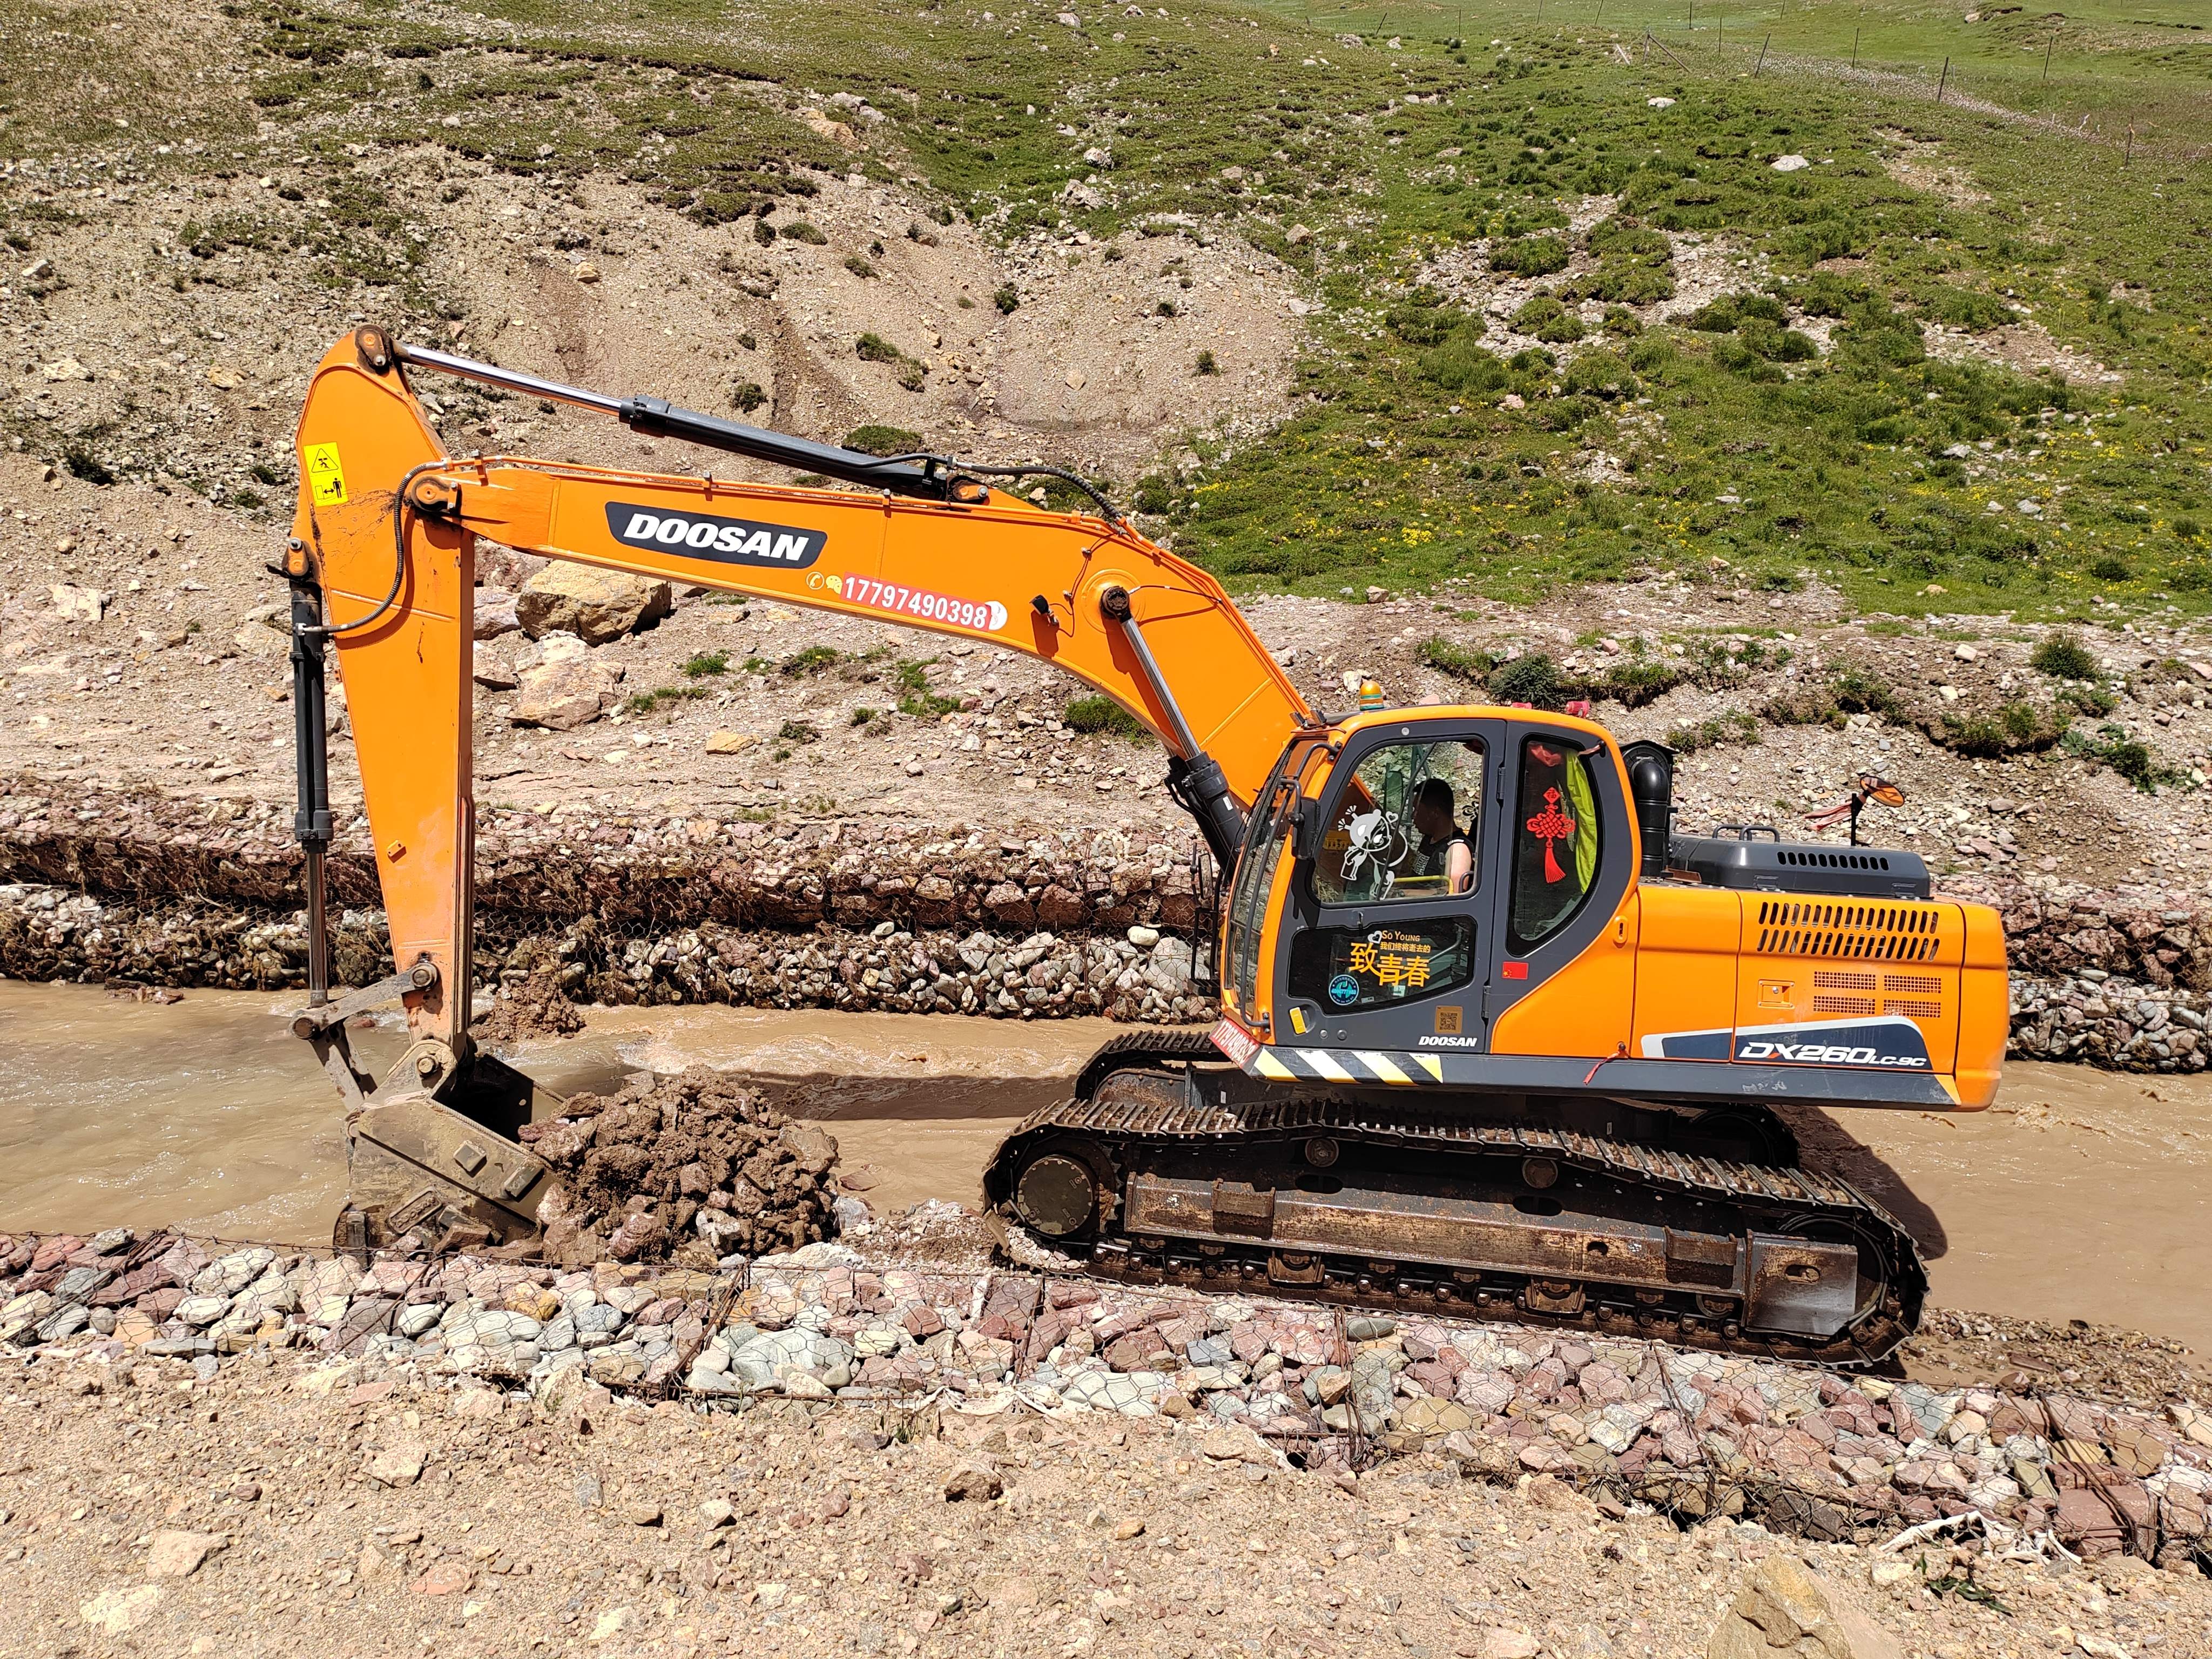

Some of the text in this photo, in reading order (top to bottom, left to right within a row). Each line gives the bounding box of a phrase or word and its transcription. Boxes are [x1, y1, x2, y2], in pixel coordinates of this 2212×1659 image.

[623, 513, 810, 561] DOOSAN
[845, 576, 988, 629] 17797490398
[1348, 942, 1431, 987] 致青春
[1380, 941, 1431, 953] 我们终将逝去的
[1418, 1036, 1478, 1047] DOOSAN
